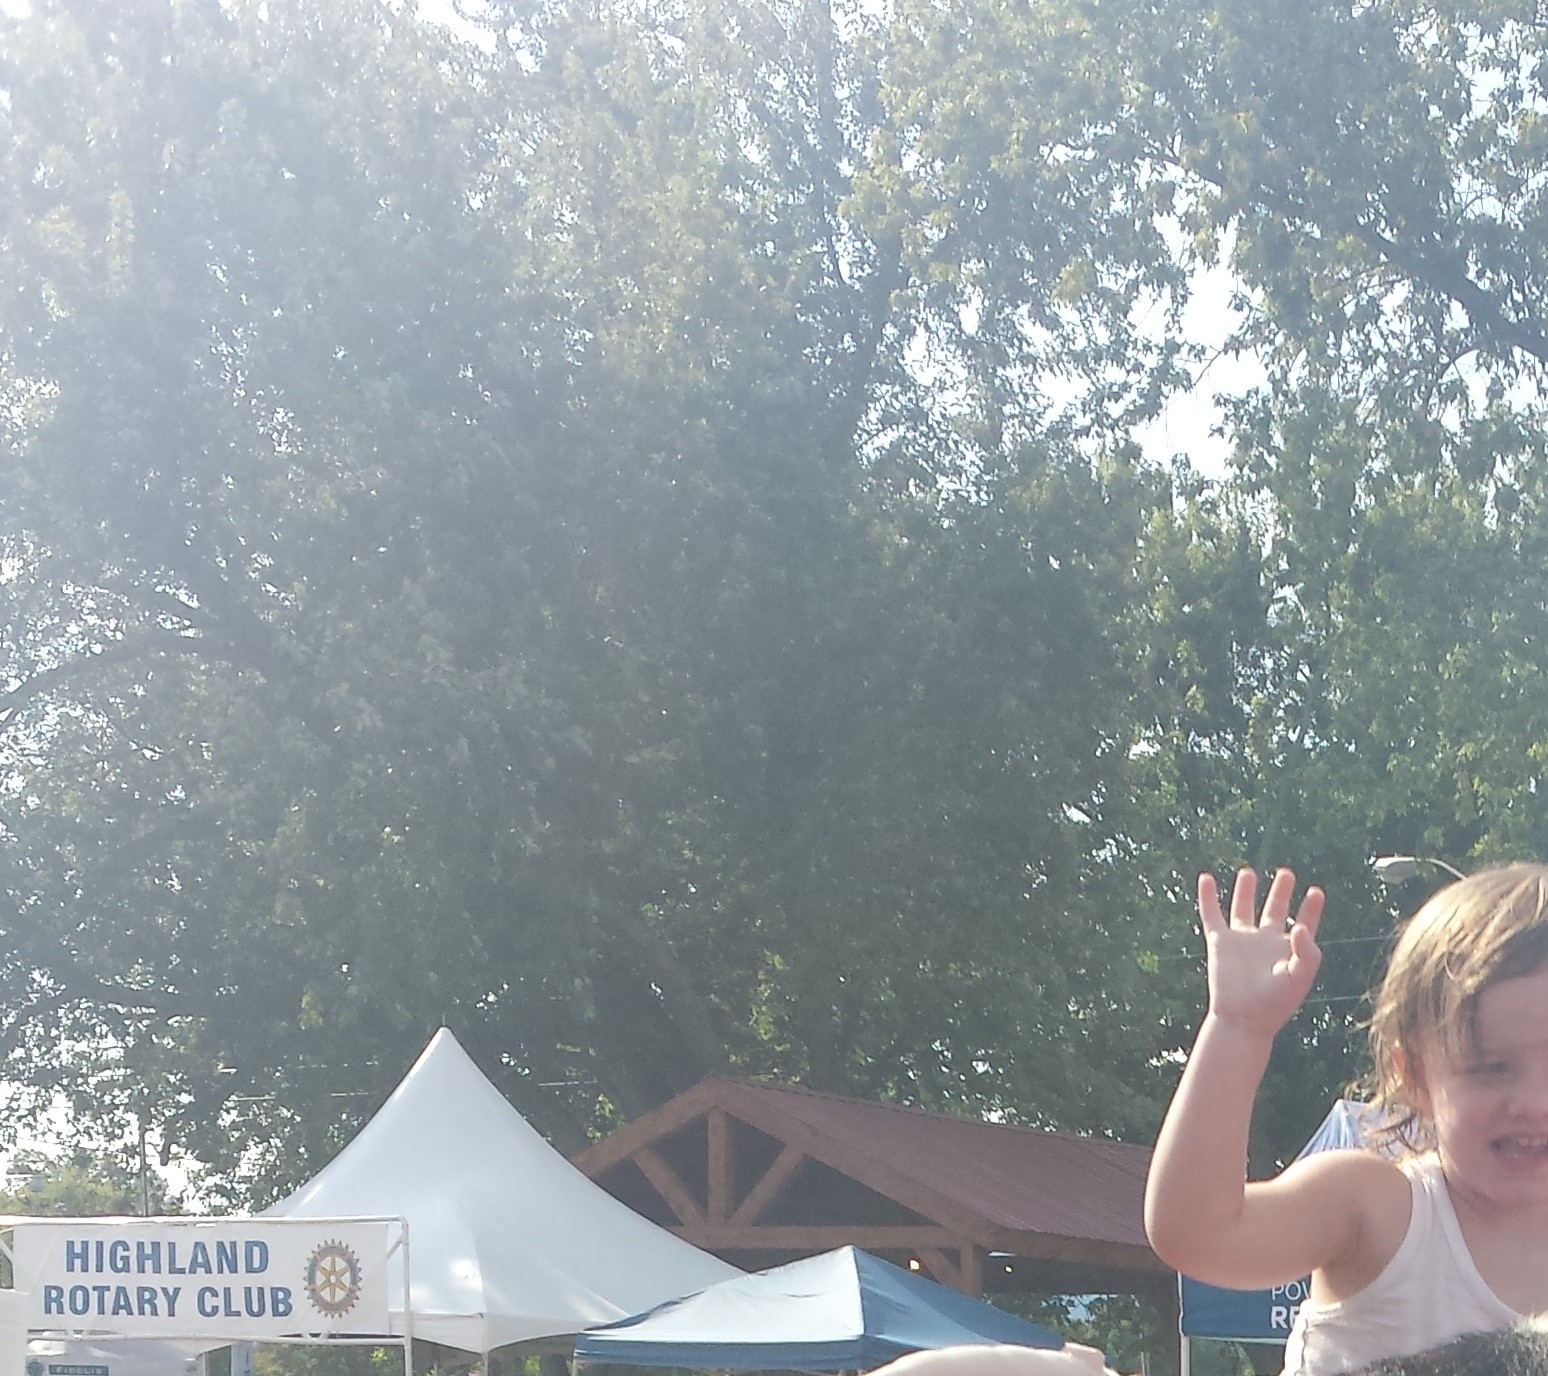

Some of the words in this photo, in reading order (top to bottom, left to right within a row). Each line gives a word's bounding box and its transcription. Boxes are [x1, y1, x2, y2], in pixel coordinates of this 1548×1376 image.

[65, 1240, 269, 1274] HIGHLAND
[44, 1285, 181, 1317] ROTARY
[197, 1286, 292, 1317] CLUB
